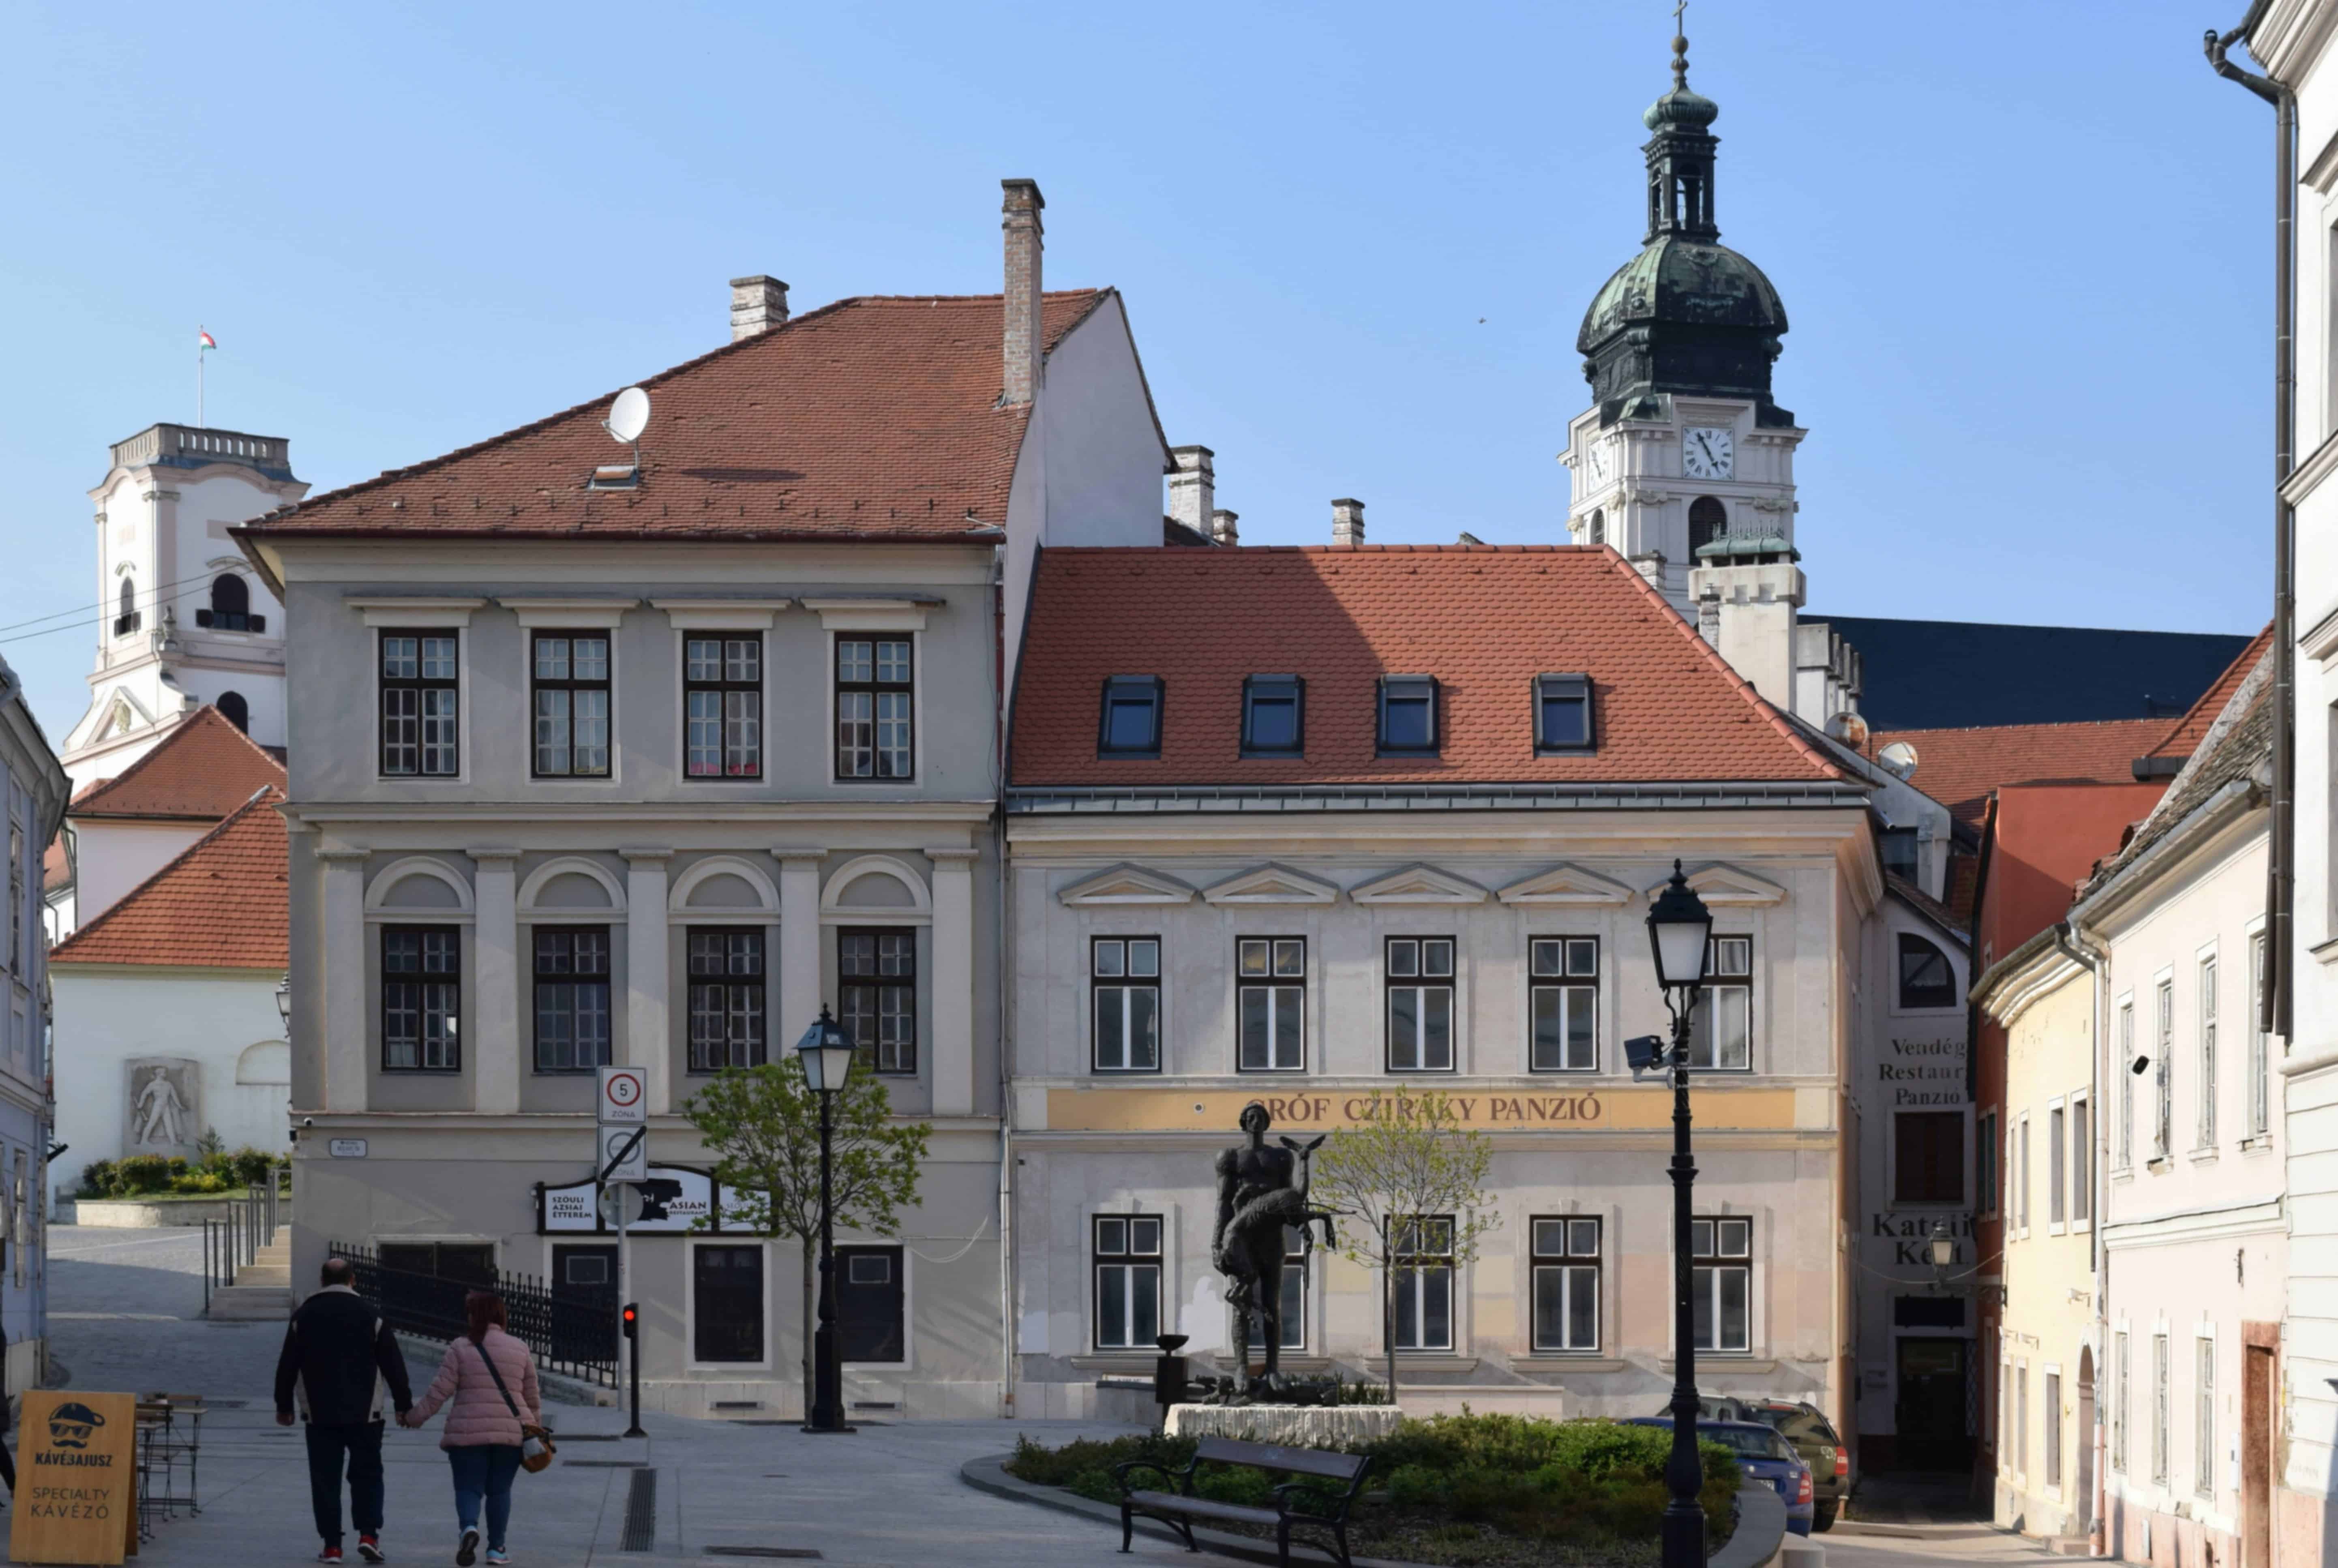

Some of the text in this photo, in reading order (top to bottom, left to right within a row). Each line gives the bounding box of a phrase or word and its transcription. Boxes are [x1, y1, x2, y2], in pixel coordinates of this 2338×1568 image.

[1892, 1038, 1966, 1059] Vendég
[1879, 1063, 1963, 1080] Restaur
[619, 1084, 628, 1097] 5
[1895, 1087, 1960, 1105] Panzió
[1248, 1093, 1330, 1121] RÓF
[1489, 1092, 1601, 1120] PANZIÓ
[32, 1487, 109, 1500] SPECIALTY
[31, 1502, 109, 1519] KÁVÉZÓ
